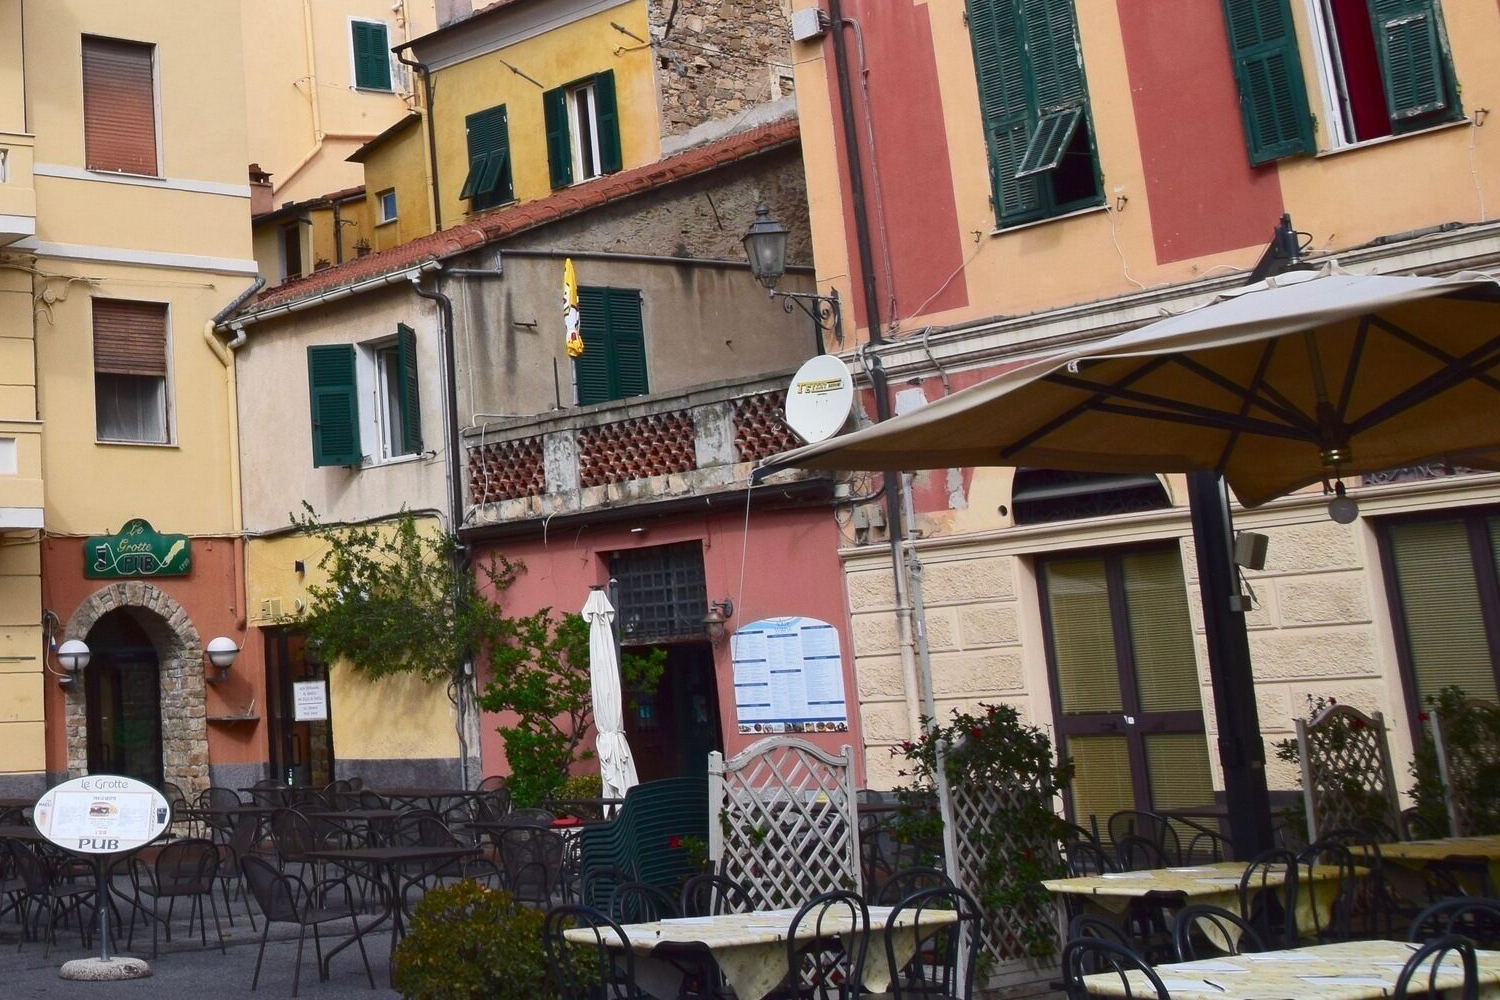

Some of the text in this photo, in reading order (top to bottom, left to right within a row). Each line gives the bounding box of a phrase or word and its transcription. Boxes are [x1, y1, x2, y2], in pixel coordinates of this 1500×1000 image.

[117, 539, 152, 552] Grotte
[123, 555, 154, 573] PUB
[94, 778, 129, 790] Grotte
[78, 838, 119, 850] PUB
